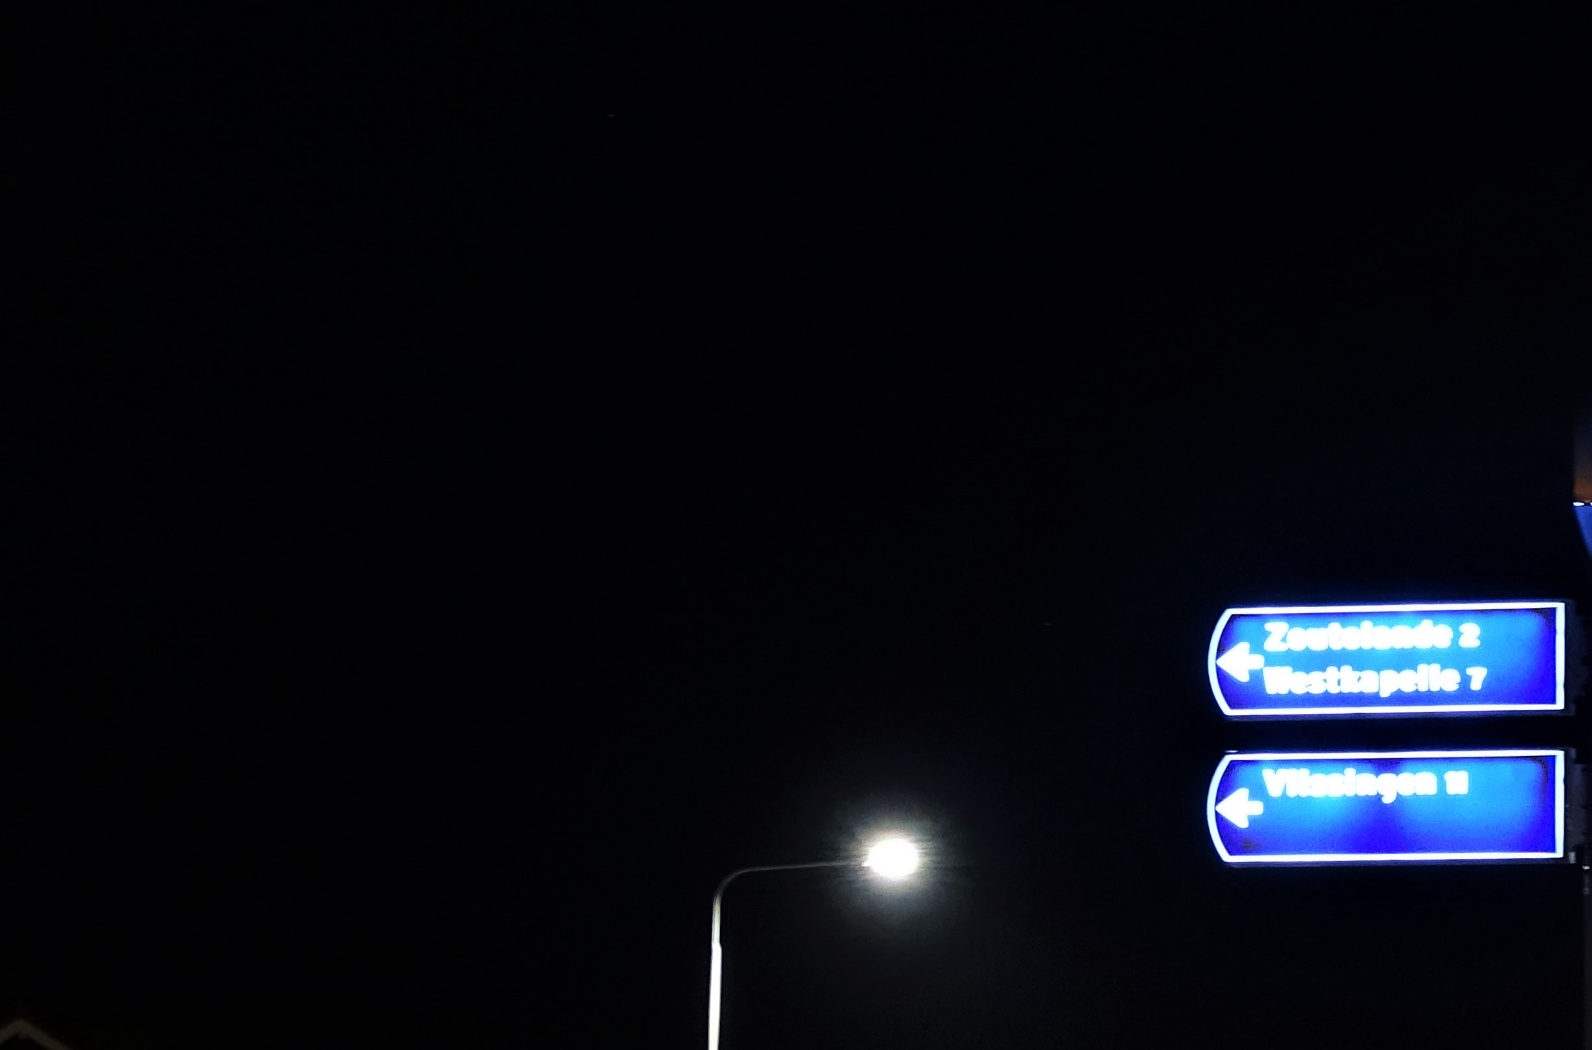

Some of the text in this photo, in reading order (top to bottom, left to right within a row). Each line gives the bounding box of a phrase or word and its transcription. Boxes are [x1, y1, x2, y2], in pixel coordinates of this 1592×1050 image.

[1264, 619, 1480, 652] Zoutelande 2
[1263, 664, 1487, 698] Westkapelle 7
[1263, 768, 1438, 804] Vlissingen
